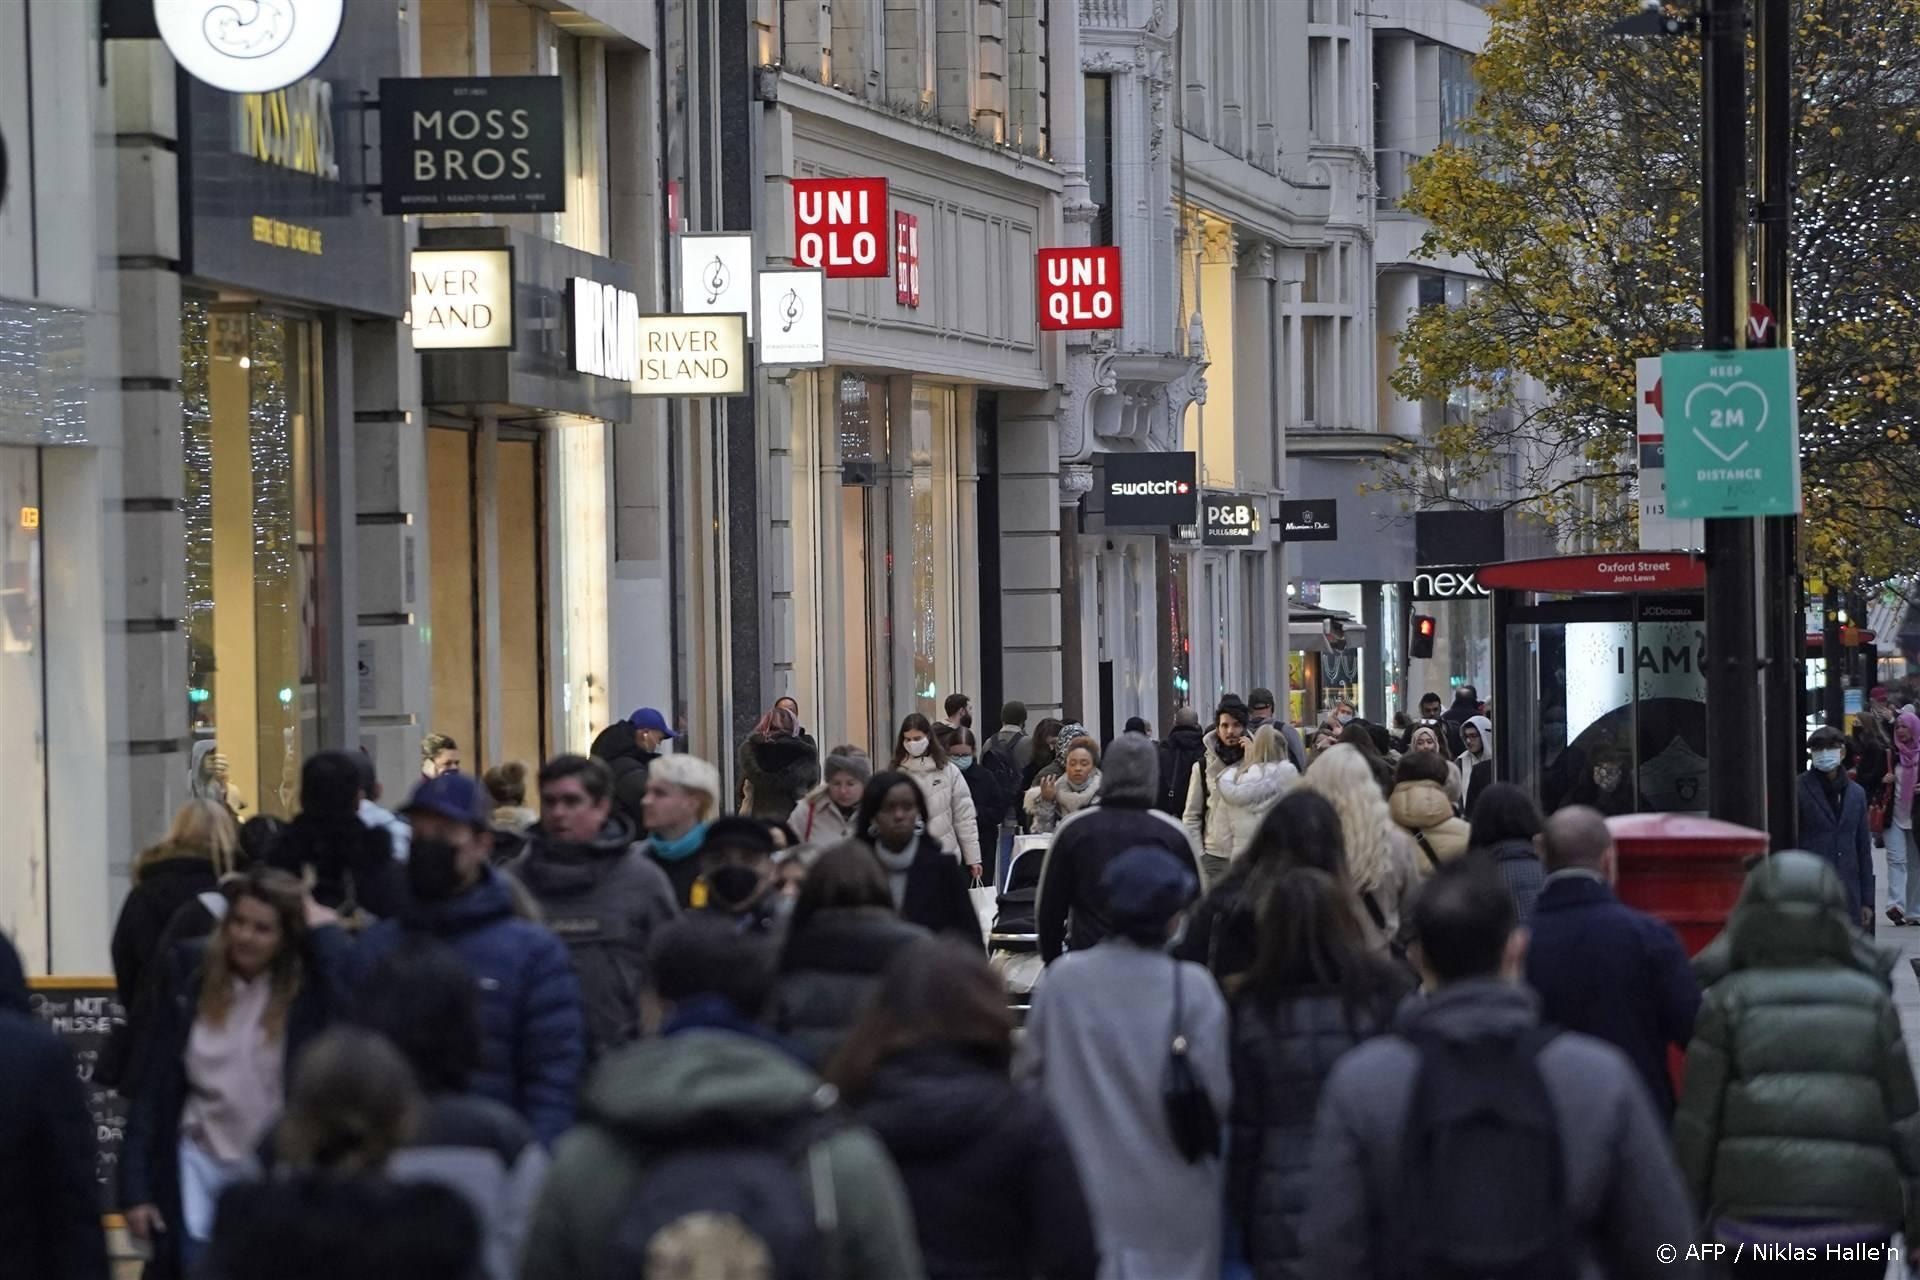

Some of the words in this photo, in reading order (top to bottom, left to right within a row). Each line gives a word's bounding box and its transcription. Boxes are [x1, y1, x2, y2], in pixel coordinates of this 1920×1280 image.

[413, 109, 529, 140] MOSS
[414, 148, 541, 181] BROS.
[799, 190, 869, 225] UNI
[800, 231, 876, 267] QLO
[1048, 257, 1105, 286] UNI
[1049, 291, 1113, 325] QLO
[648, 331, 718, 352] RIVER
[640, 358, 728, 380] ISLAND
[1709, 365, 1742, 377] KEEP
[1710, 408, 1744, 428] 2M
[1697, 468, 1762, 481] DISTANCE
[1111, 480, 1177, 495] swatch
[1207, 505, 1250, 525] P&B
[1597, 562, 1635, 572] Oxford
[1638, 561, 1670, 571] Street
[1633, 574, 1656, 582] Lewis
[1618, 647, 1624, 674] I
[1637, 646, 1690, 673] AM
